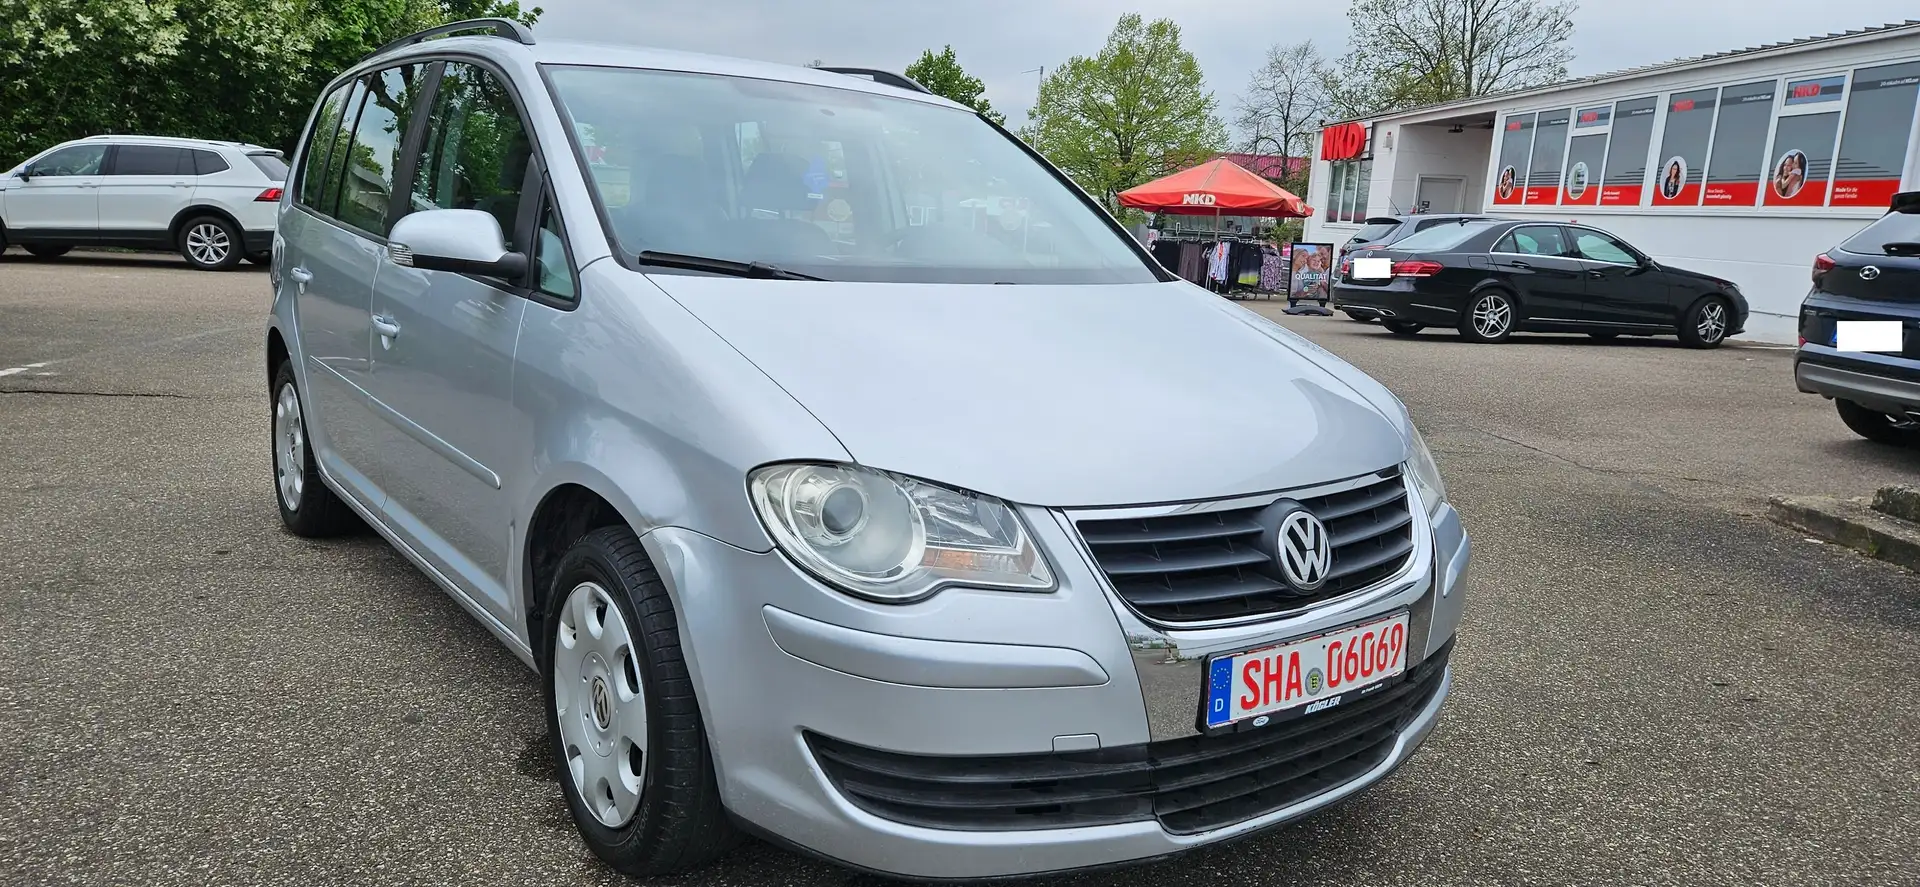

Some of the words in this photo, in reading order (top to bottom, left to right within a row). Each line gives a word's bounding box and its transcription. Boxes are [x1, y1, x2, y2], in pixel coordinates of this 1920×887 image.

[1321, 122, 1366, 160] NKD
[1182, 193, 1216, 205] NKD
[1241, 651, 1302, 710] SHA
[1327, 623, 1403, 688] 06069
[1214, 698, 1224, 713] D
[1304, 695, 1341, 715] KÖGLER
